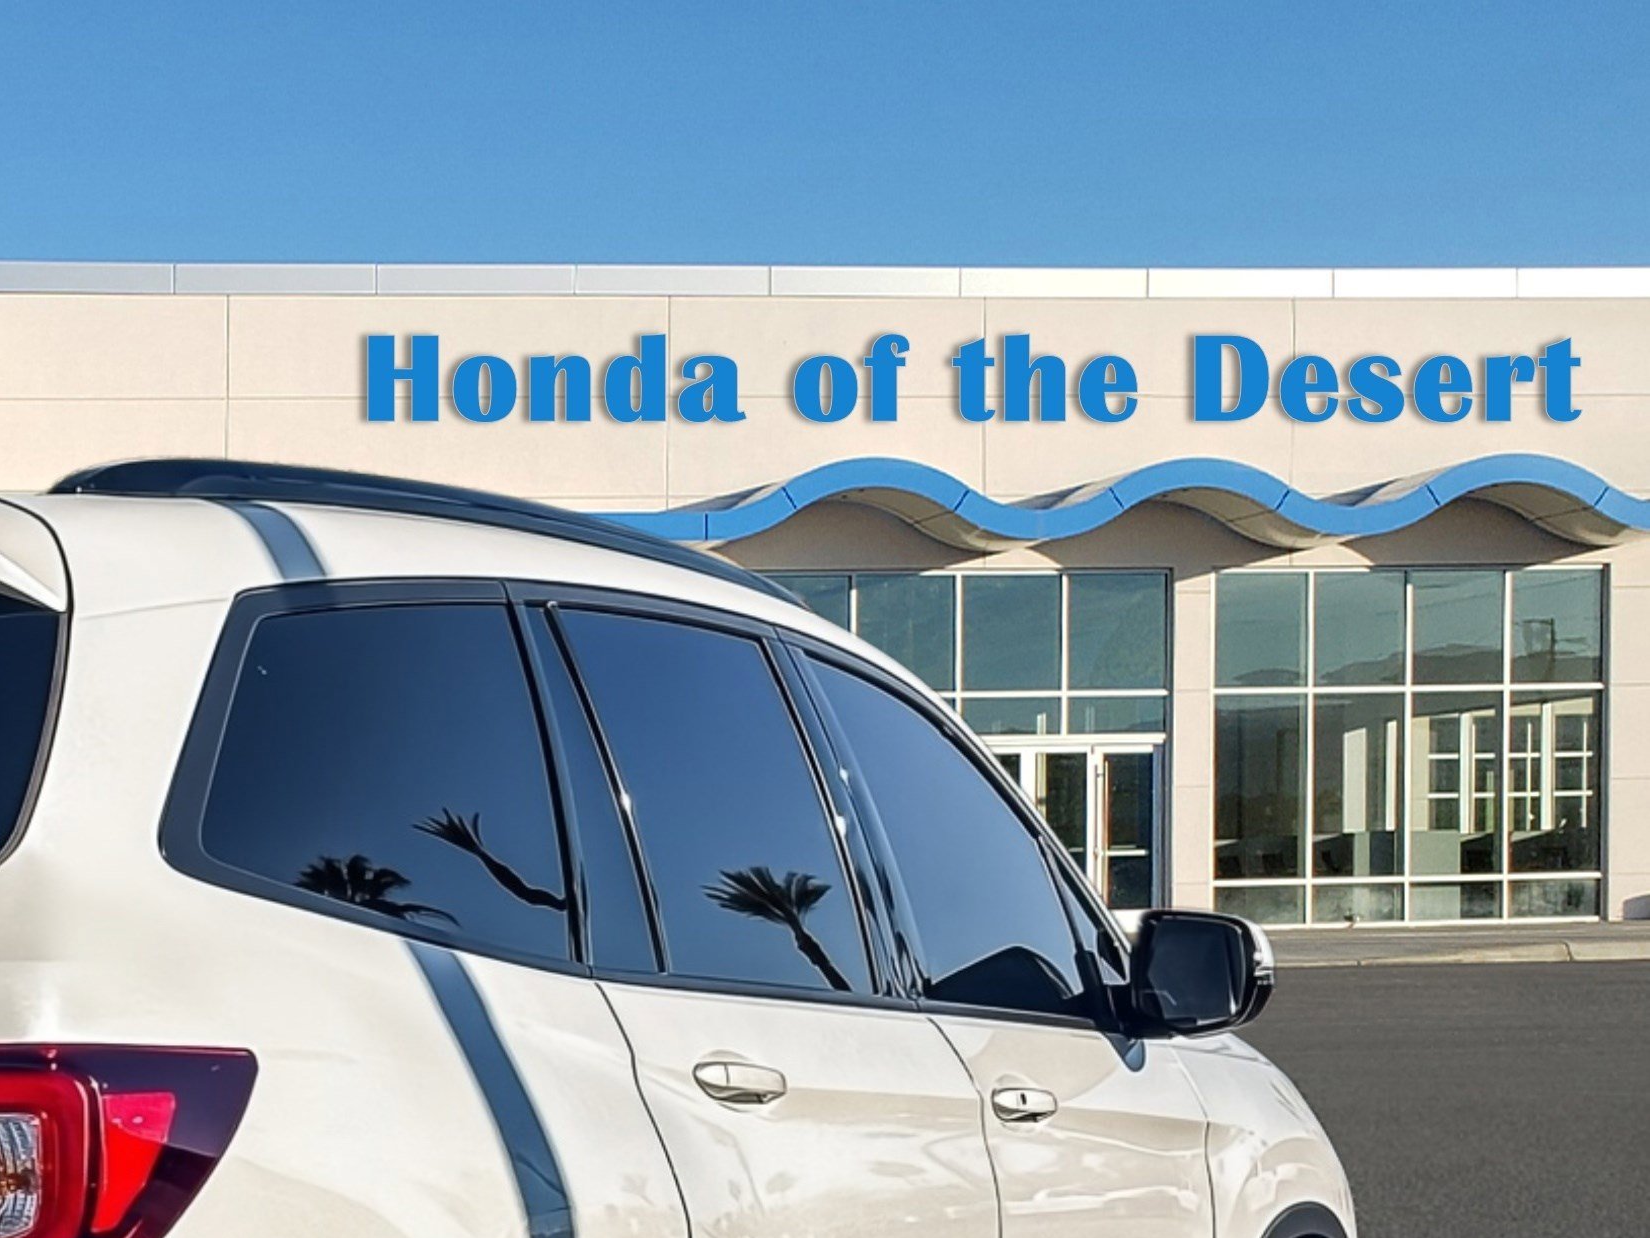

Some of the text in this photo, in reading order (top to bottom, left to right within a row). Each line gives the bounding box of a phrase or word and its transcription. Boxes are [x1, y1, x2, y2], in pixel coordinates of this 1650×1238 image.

[366, 333, 1582, 423] Honda of the Desert
